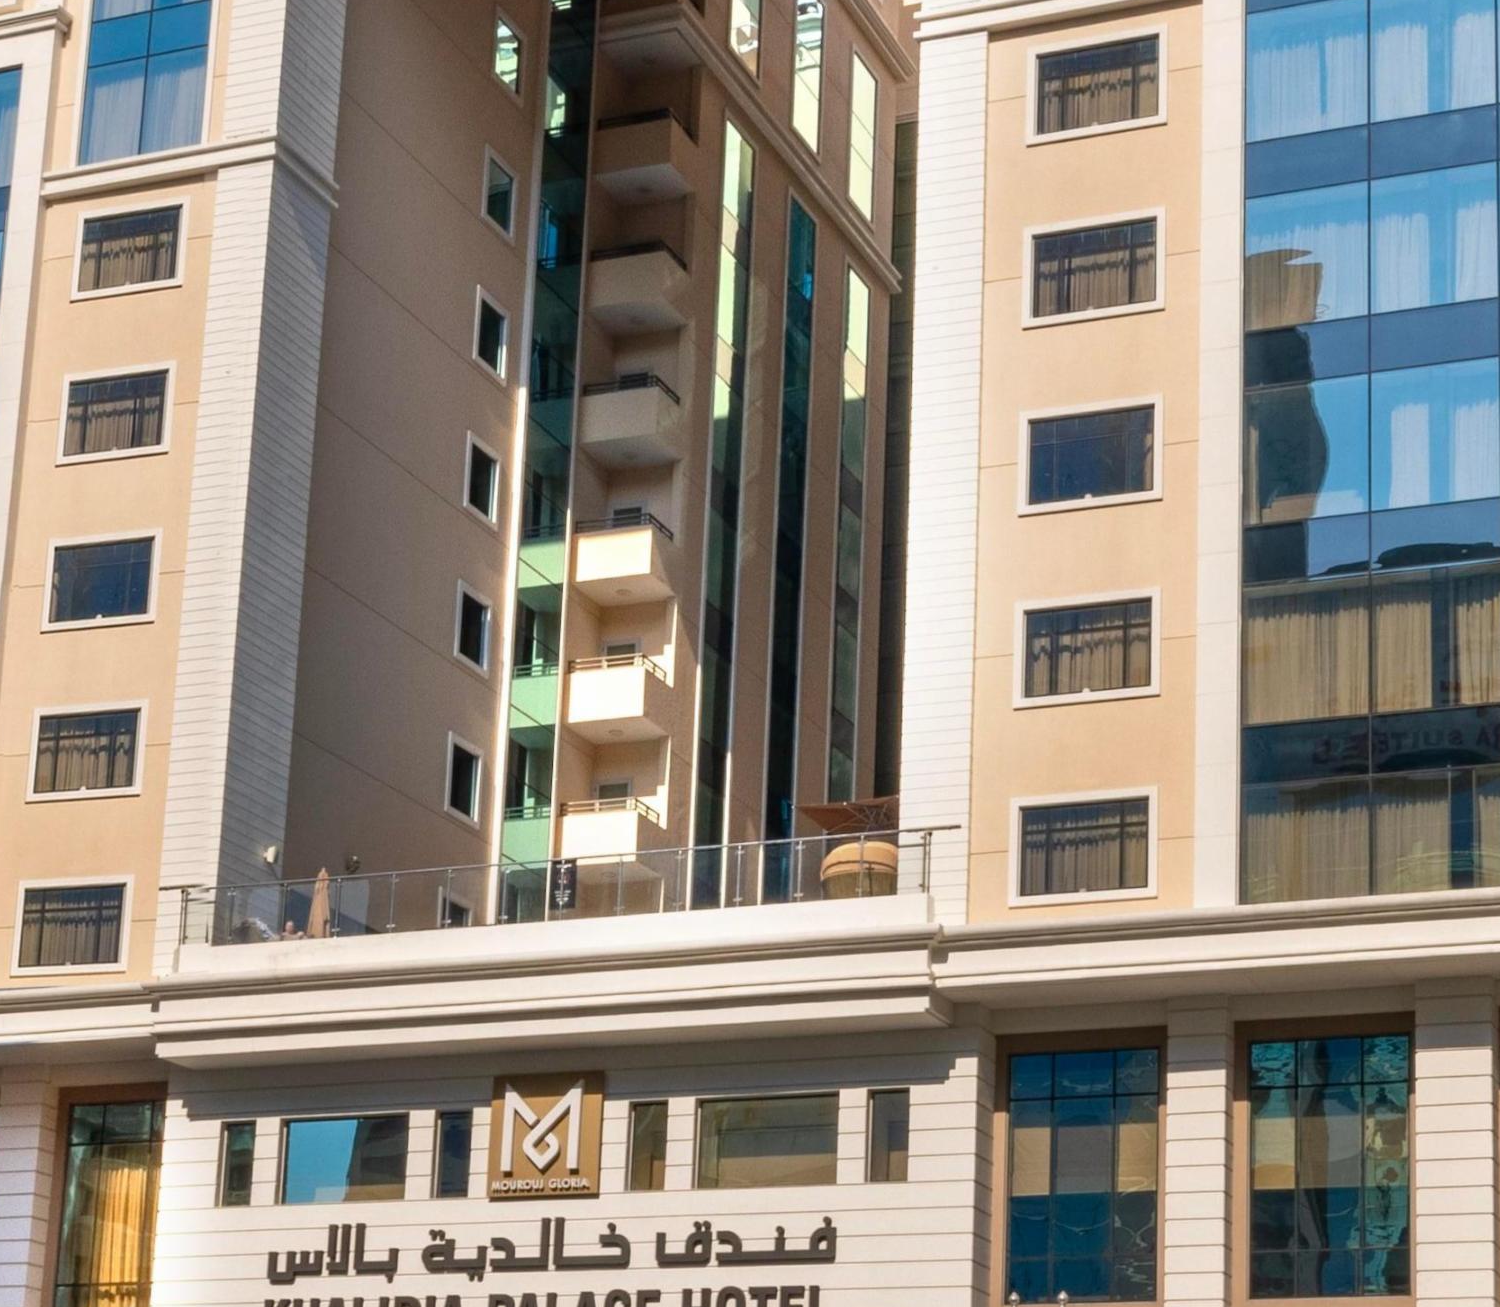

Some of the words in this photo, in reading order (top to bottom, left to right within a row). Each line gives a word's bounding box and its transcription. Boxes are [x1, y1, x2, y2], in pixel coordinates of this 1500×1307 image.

[491, 1179, 545, 1192] MOUROUJ
[548, 1176, 590, 1191] GLORIA
[267, 1223, 400, 1285] بالاس
[421, 1217, 631, 1282] خالدية
[655, 1216, 838, 1268] فندق
